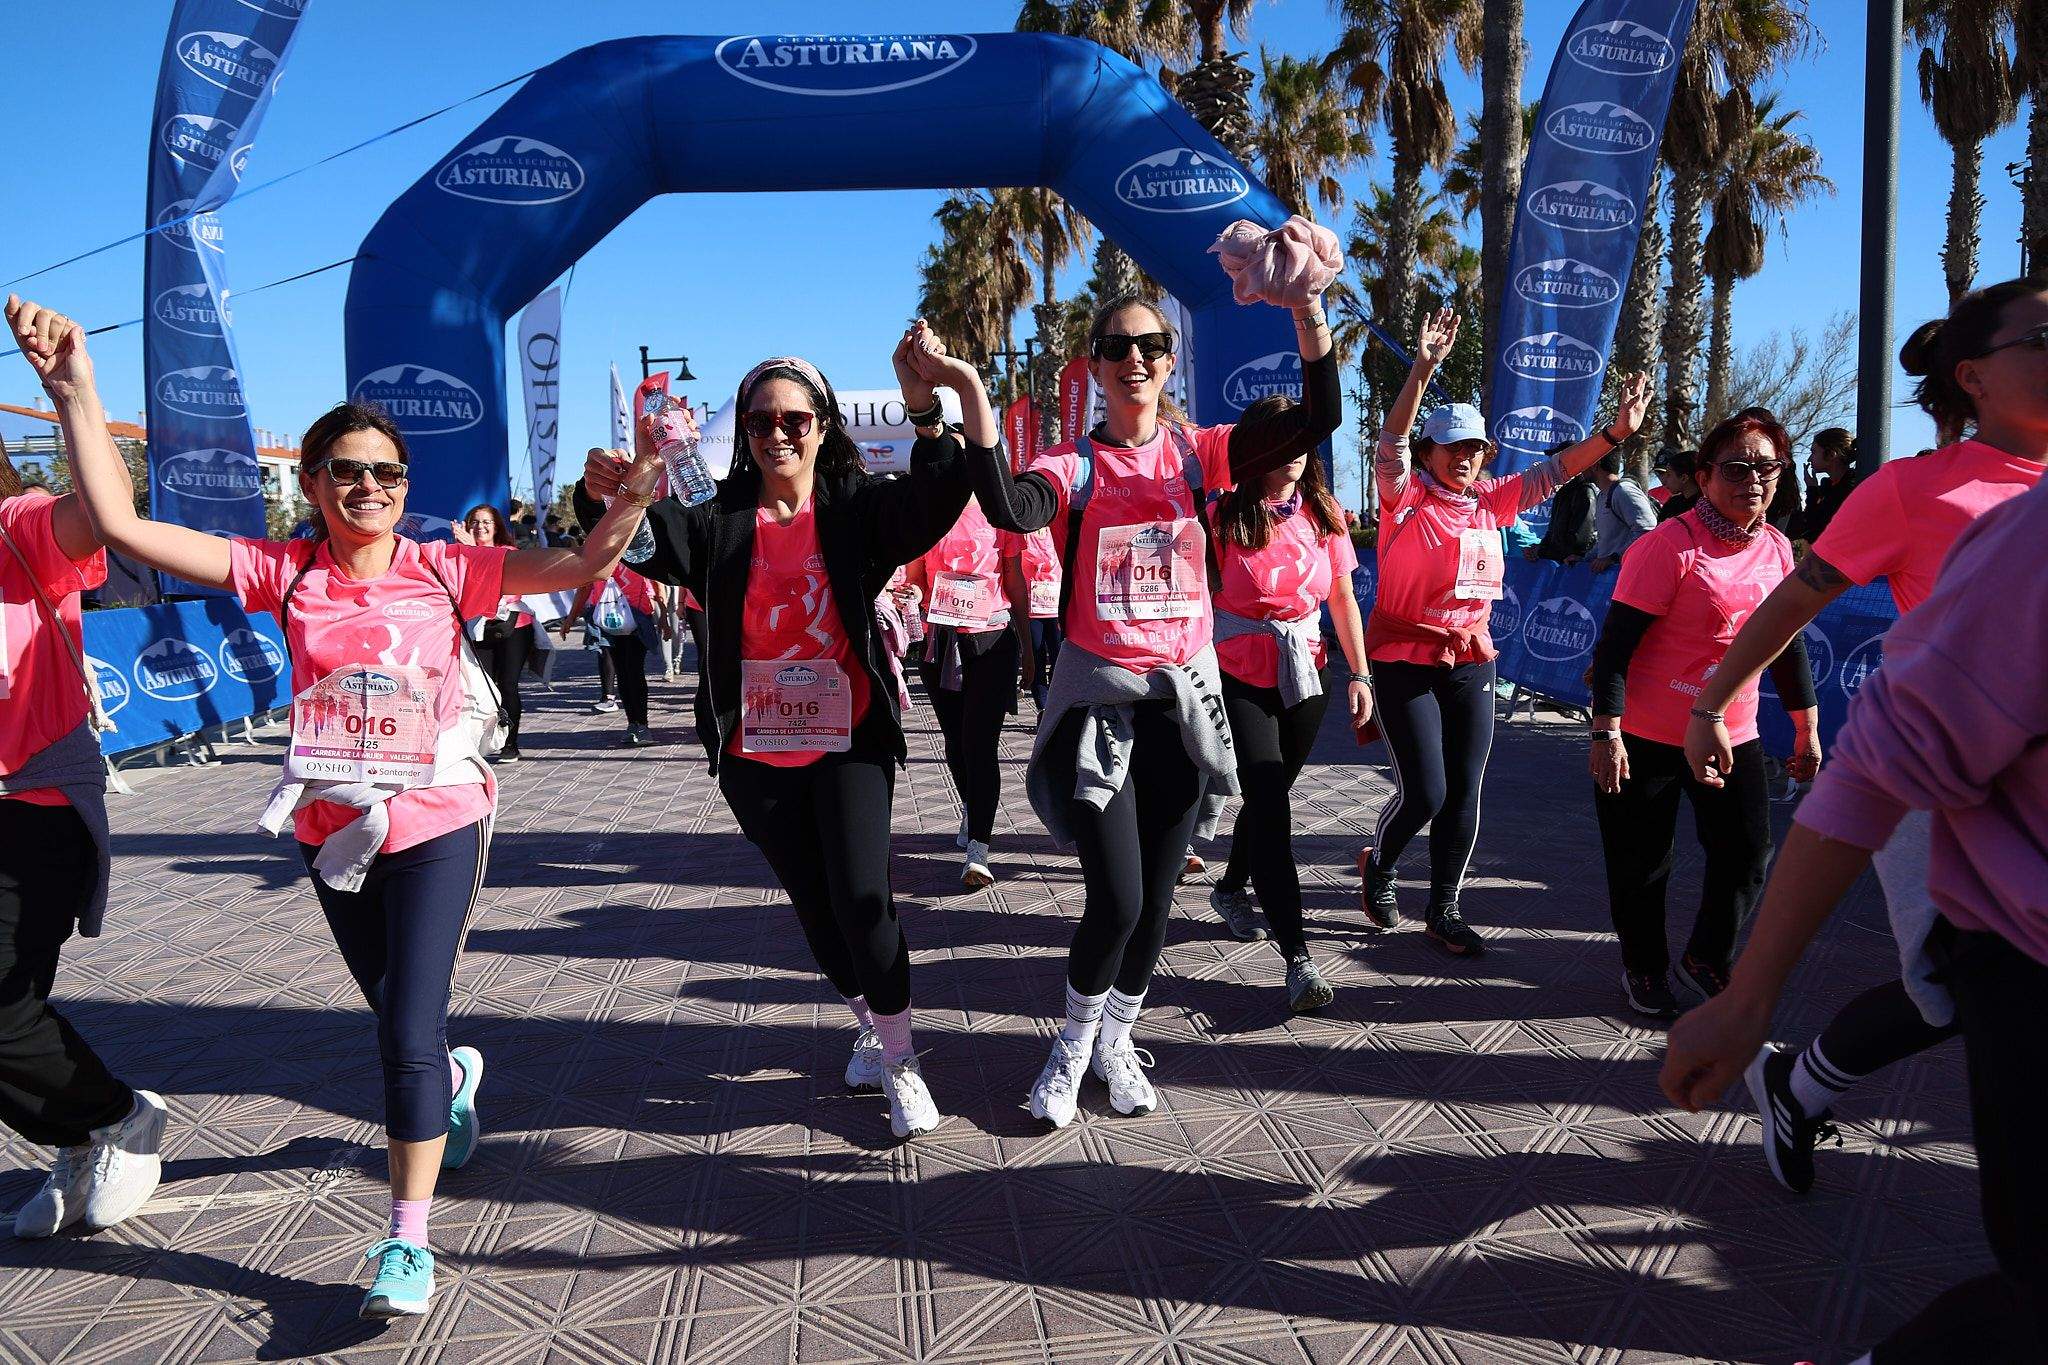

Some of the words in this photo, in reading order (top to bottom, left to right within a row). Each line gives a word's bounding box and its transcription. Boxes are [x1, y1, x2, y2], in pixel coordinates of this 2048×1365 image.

[736, 38, 960, 68] ASTURIANA
[1574, 36, 1666, 67] ASTURIANA
[184, 40, 268, 88] ASTURIA
[1552, 115, 1644, 146] ASTURIANA
[444, 163, 574, 190] ASTURIANA
[1127, 175, 1242, 199] ASTURIANA
[1534, 194, 1627, 222] ASTURIANA
[1520, 274, 1610, 299] ASTURIANA
[1510, 348, 1593, 372] ASTURIANA
[1501, 421, 1577, 443] ASTURIANA
[165, 465, 259, 489] ASTURIANA
[1133, 565, 1172, 581] 016
[1140, 585, 1159, 593] 6286
[952, 597, 974, 609] 016
[1103, 632, 1145, 645] CARRERA
[1148, 631, 1163, 643] DE
[224, 650, 280, 674] ASTURIANA
[142, 662, 214, 691] ASTURIANA
[343, 680, 395, 692] ASTURIANA
[779, 674, 816, 682] ASTURIANA
[780, 701, 820, 716] 016
[345, 715, 397, 736] 016
[310, 748, 341, 757] CARRERA
[361, 752, 384, 760] MUJER
[389, 754, 420, 762] VALENCIA
[354, 740, 379, 749] 7425
[306, 762, 352, 774] OYSHO
[379, 768, 421, 777] Santander
